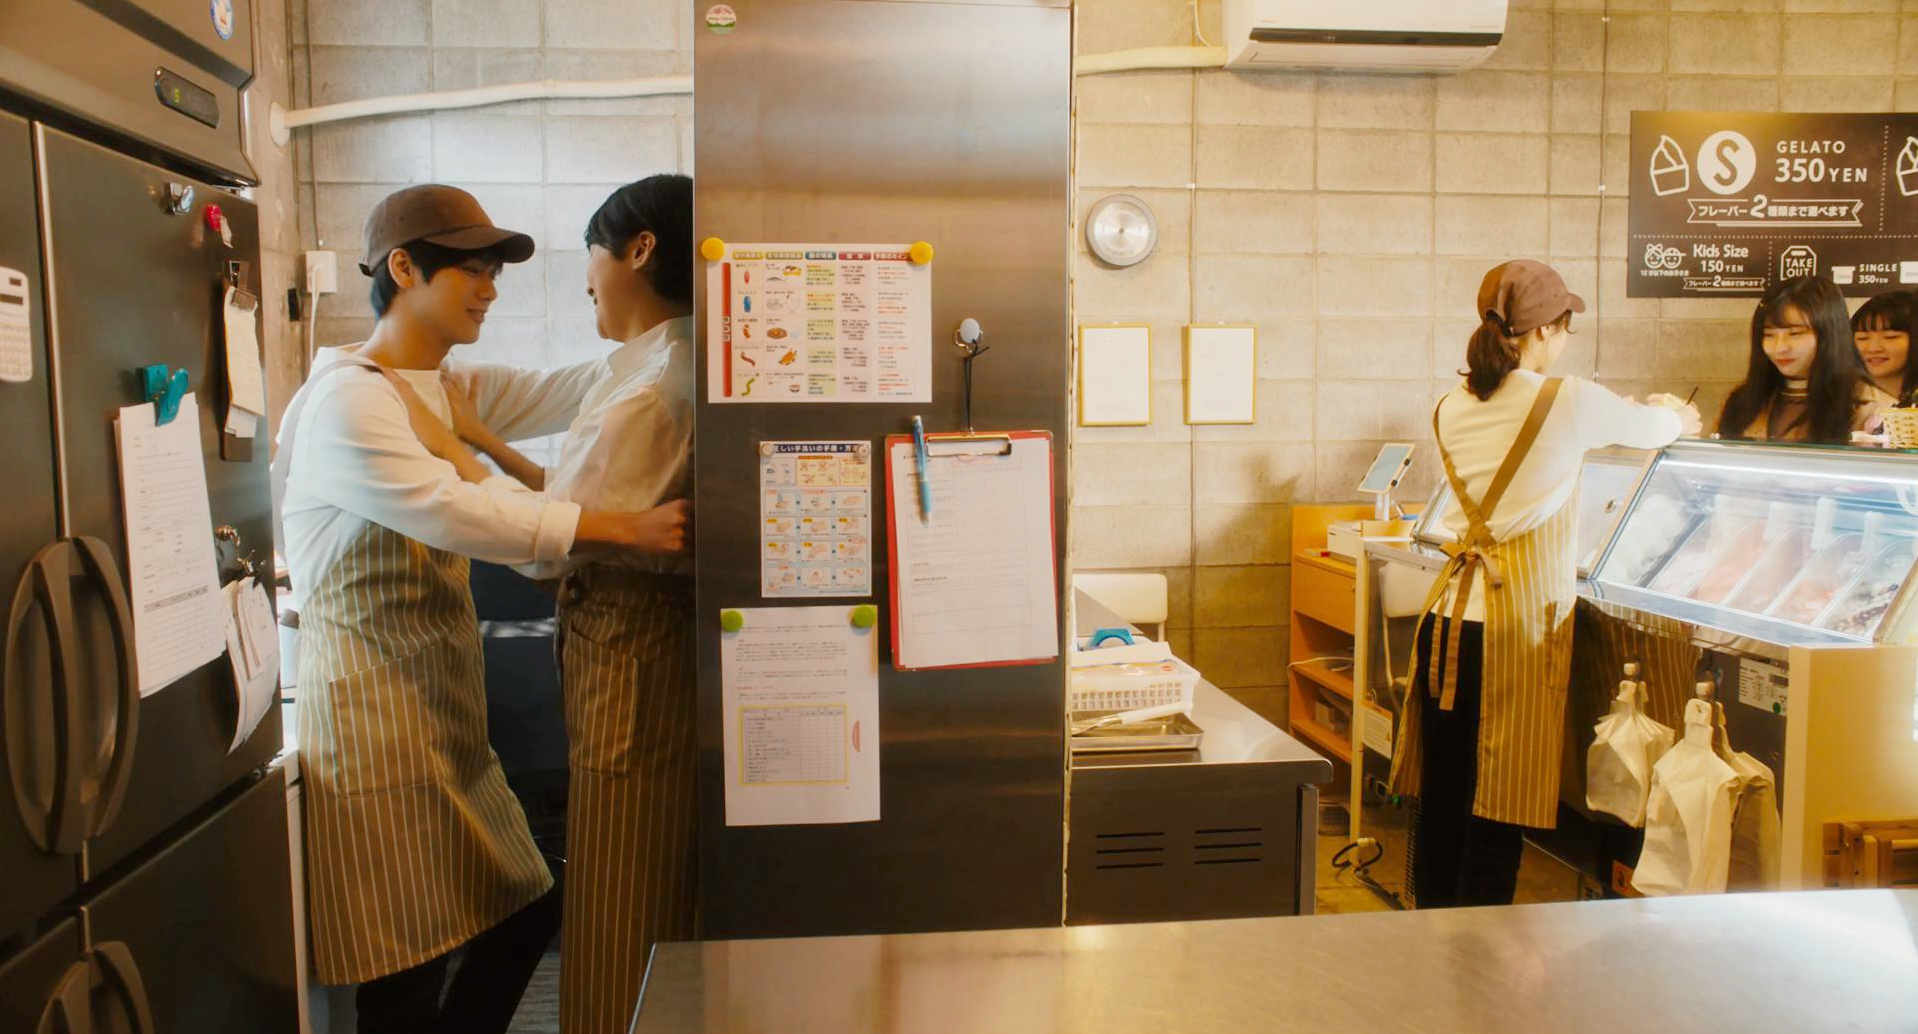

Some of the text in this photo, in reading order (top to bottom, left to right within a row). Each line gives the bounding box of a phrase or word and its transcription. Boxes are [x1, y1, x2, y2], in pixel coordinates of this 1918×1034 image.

[1776, 140, 1846, 154] GELATO
[1713, 138, 1740, 187] S
[1775, 158, 1868, 183] 350 YEN
[1693, 243, 1749, 258] Kids Size
[1701, 260, 1744, 273] 150 YEN
[1785, 258, 1812, 268] TAKE
[1859, 263, 1897, 272] SINGLE
[1786, 268, 1810, 278] OUT
